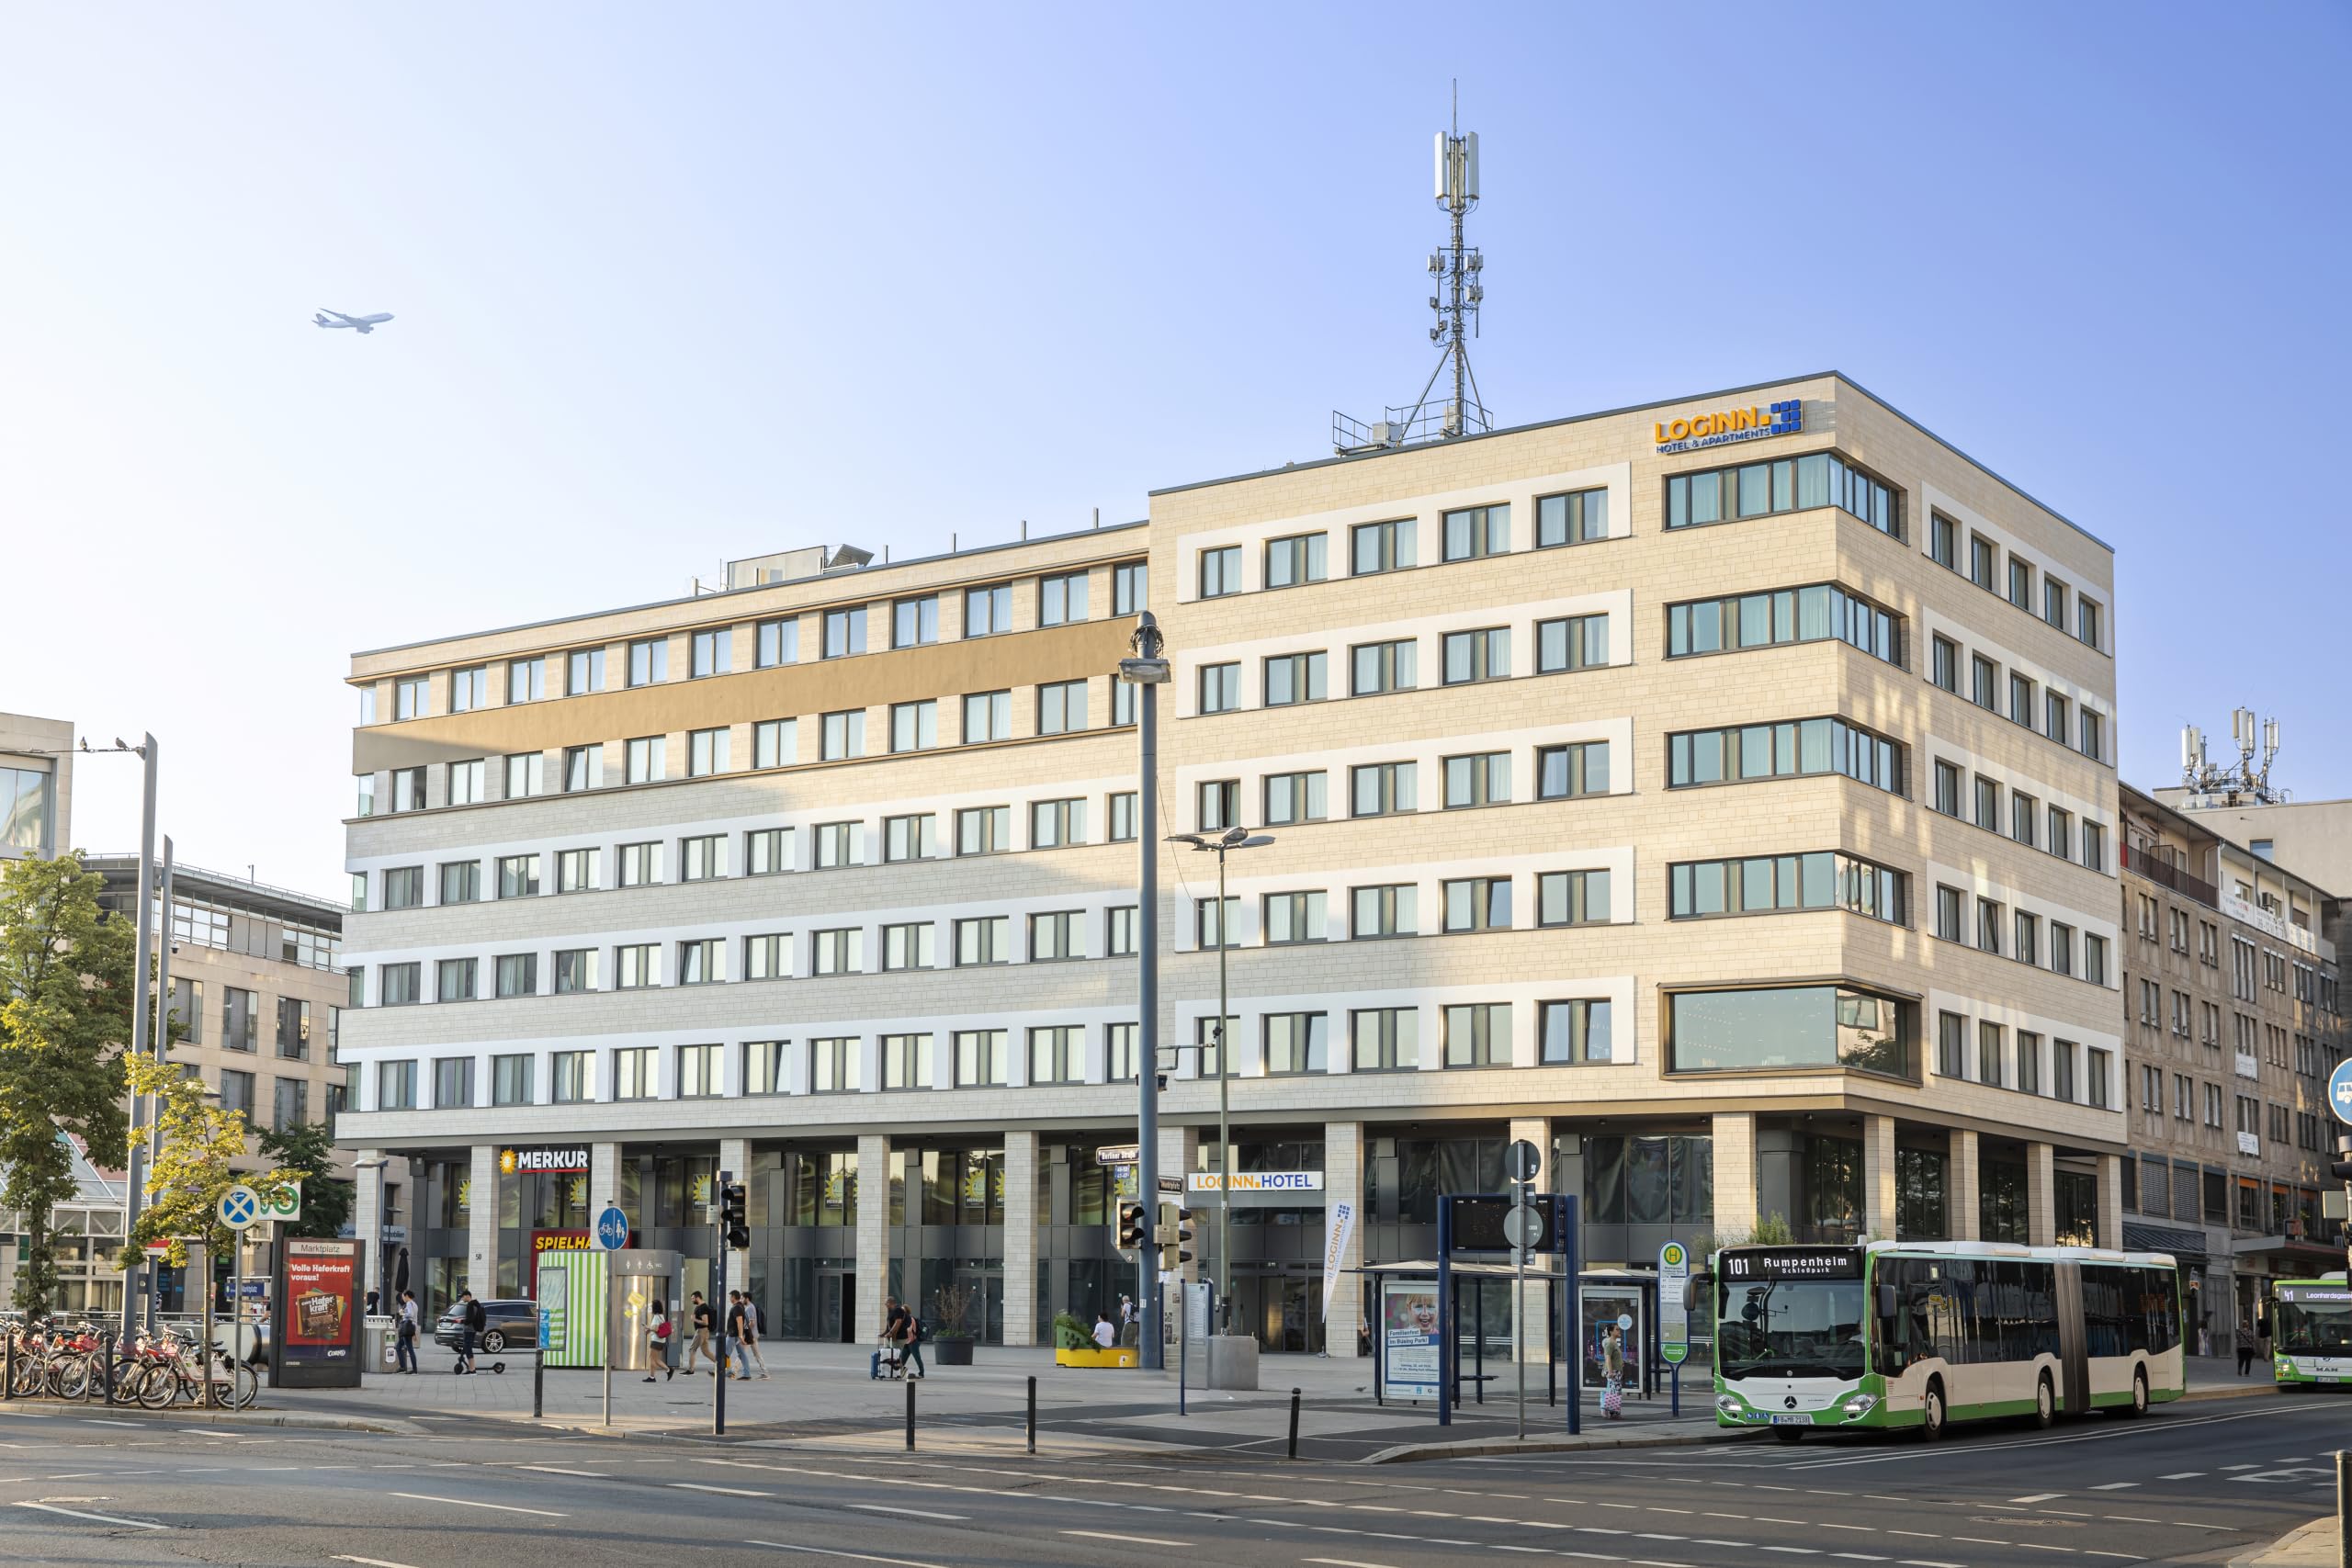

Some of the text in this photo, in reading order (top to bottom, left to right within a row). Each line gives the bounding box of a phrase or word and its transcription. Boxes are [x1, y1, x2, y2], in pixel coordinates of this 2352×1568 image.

[1656, 427, 1770, 454] HOTEL & APARTMENTS
[517, 1150, 588, 1168] MERKUR
[300, 1244, 340, 1253] Marktplatz
[536, 1236, 591, 1250] SPIELHA
[312, 1264, 351, 1273] Haferkraft
[1727, 1257, 1848, 1275] 101 Rumpenheim
[290, 1273, 320, 1281] voraus!
[311, 1295, 334, 1306] Hafer
[2284, 1290, 2294, 1302] 41
[309, 1303, 328, 1313] kraft
